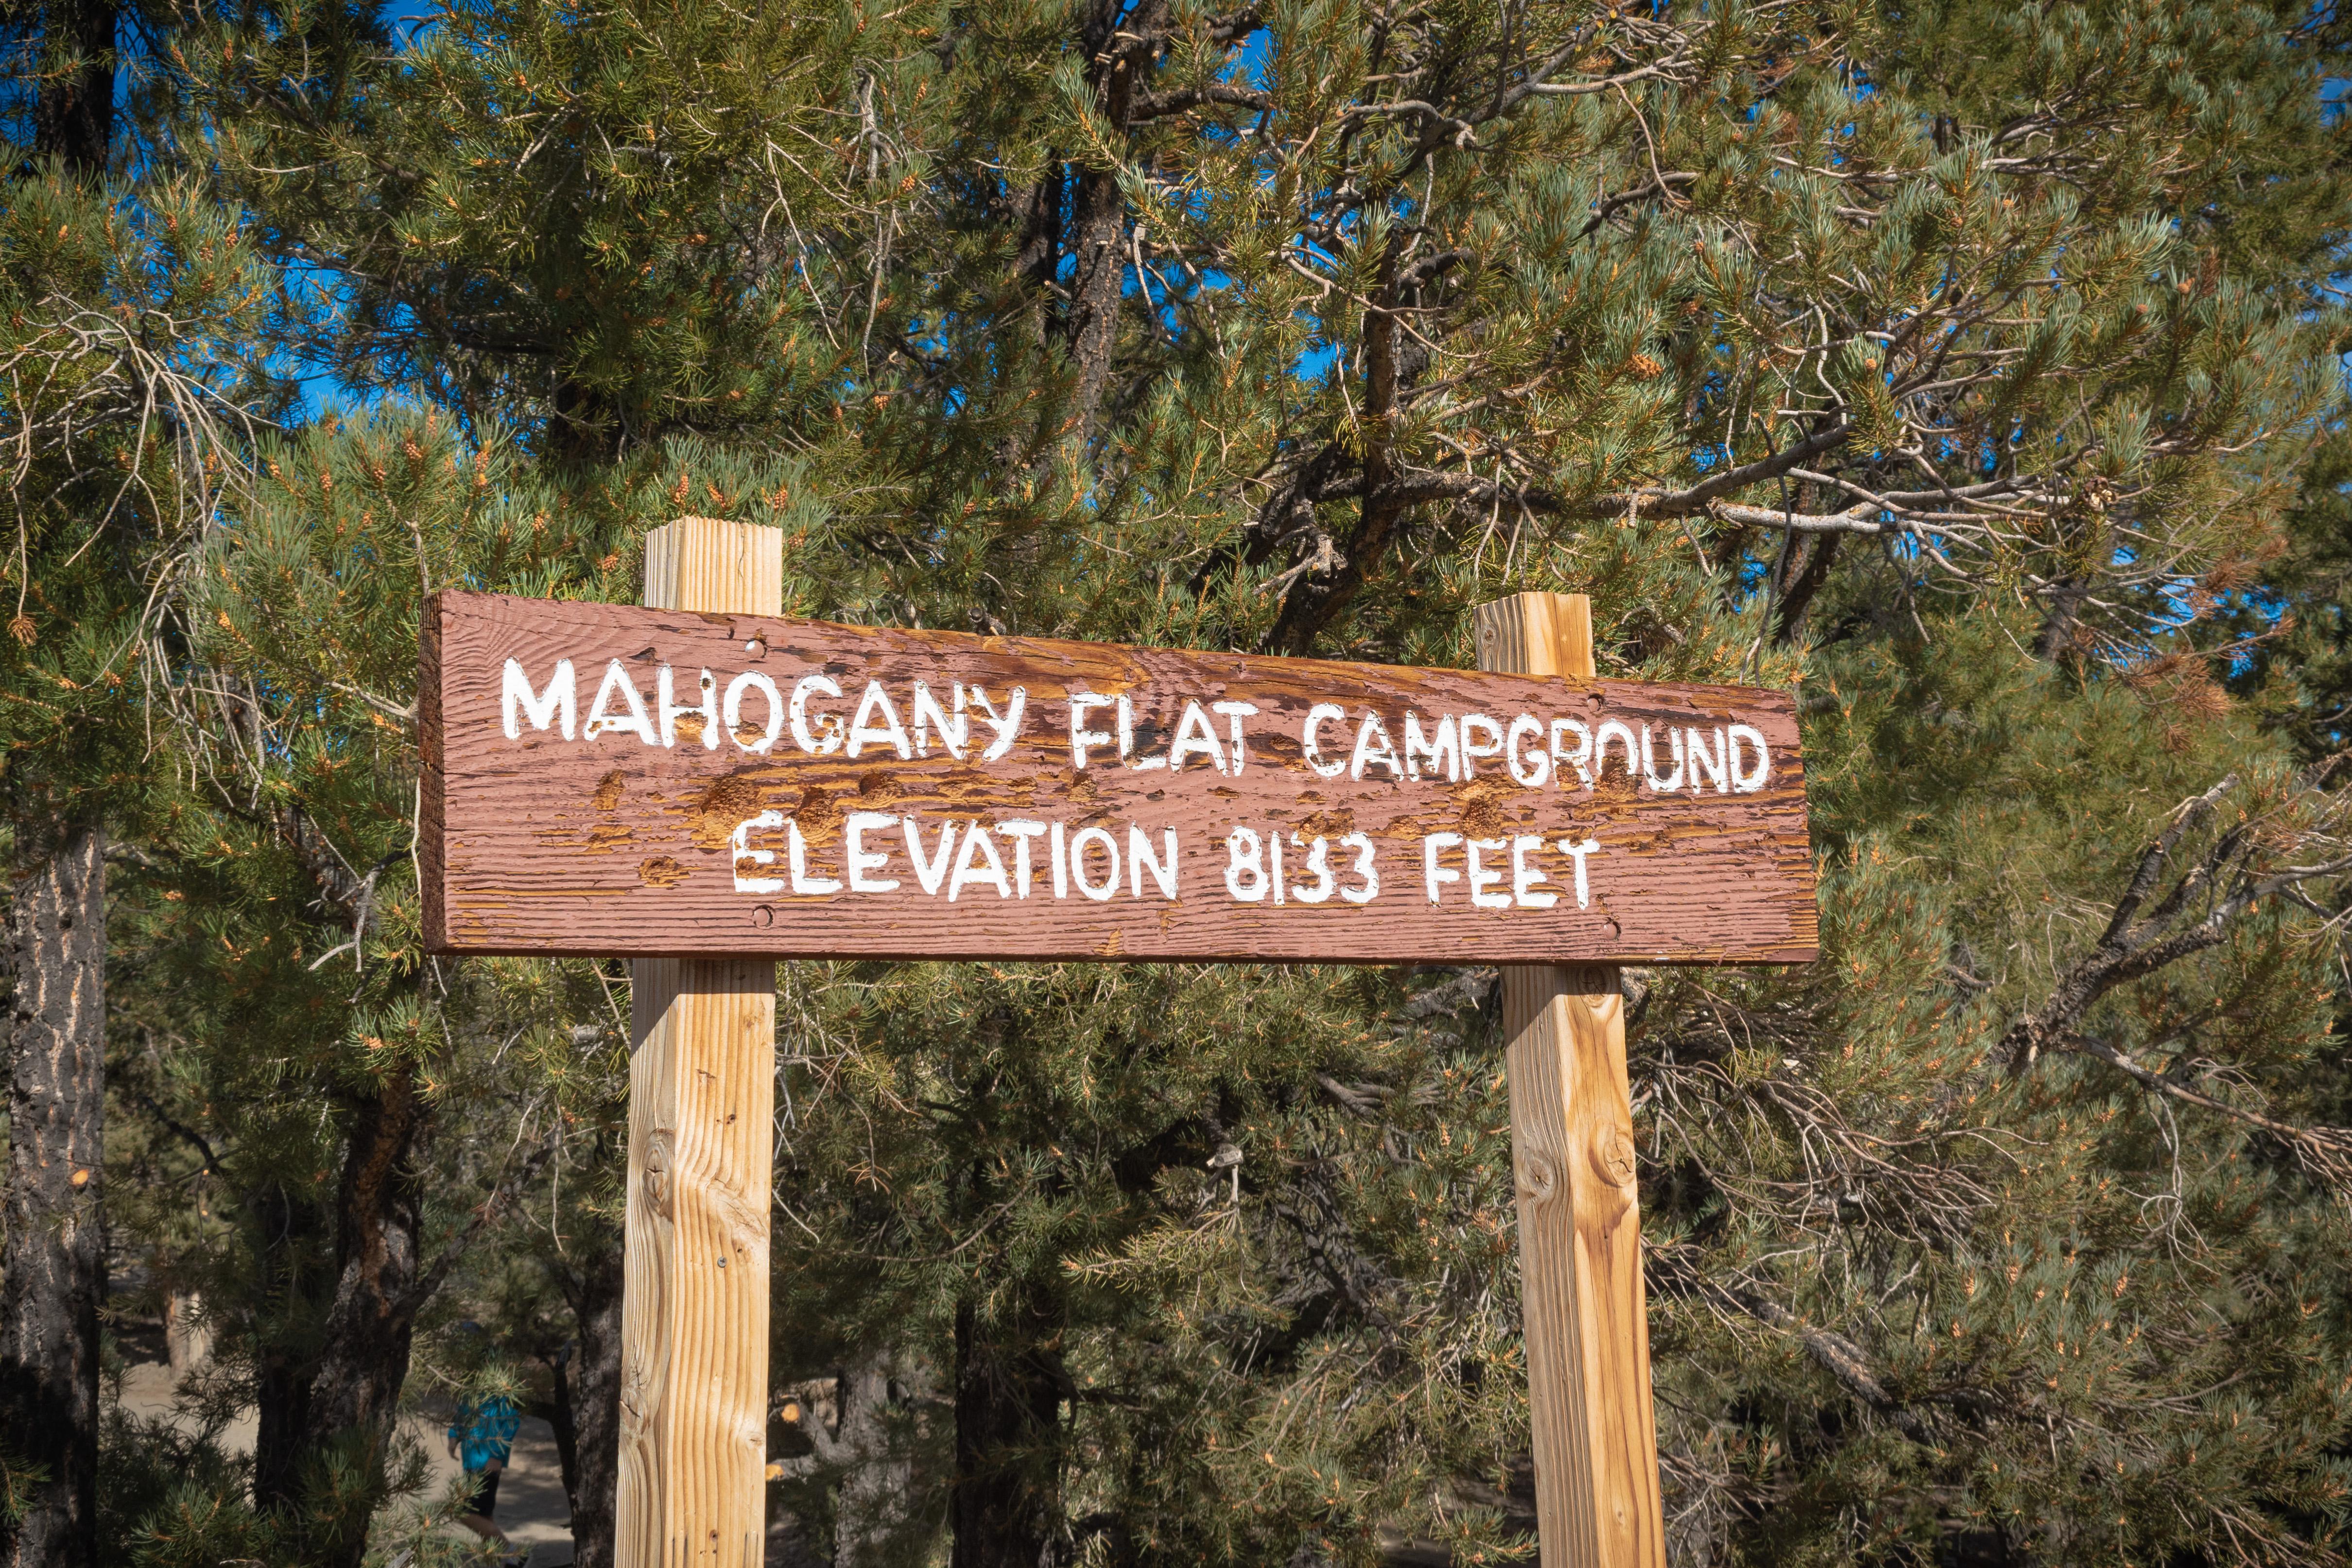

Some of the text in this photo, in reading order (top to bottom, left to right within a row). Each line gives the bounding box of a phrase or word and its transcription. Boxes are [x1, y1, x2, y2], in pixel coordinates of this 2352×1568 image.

[502, 655, 1770, 794] MAHOGANY FLAT CAMPGROUND
[733, 809, 1601, 910] ELEVATION 8133 FEET
